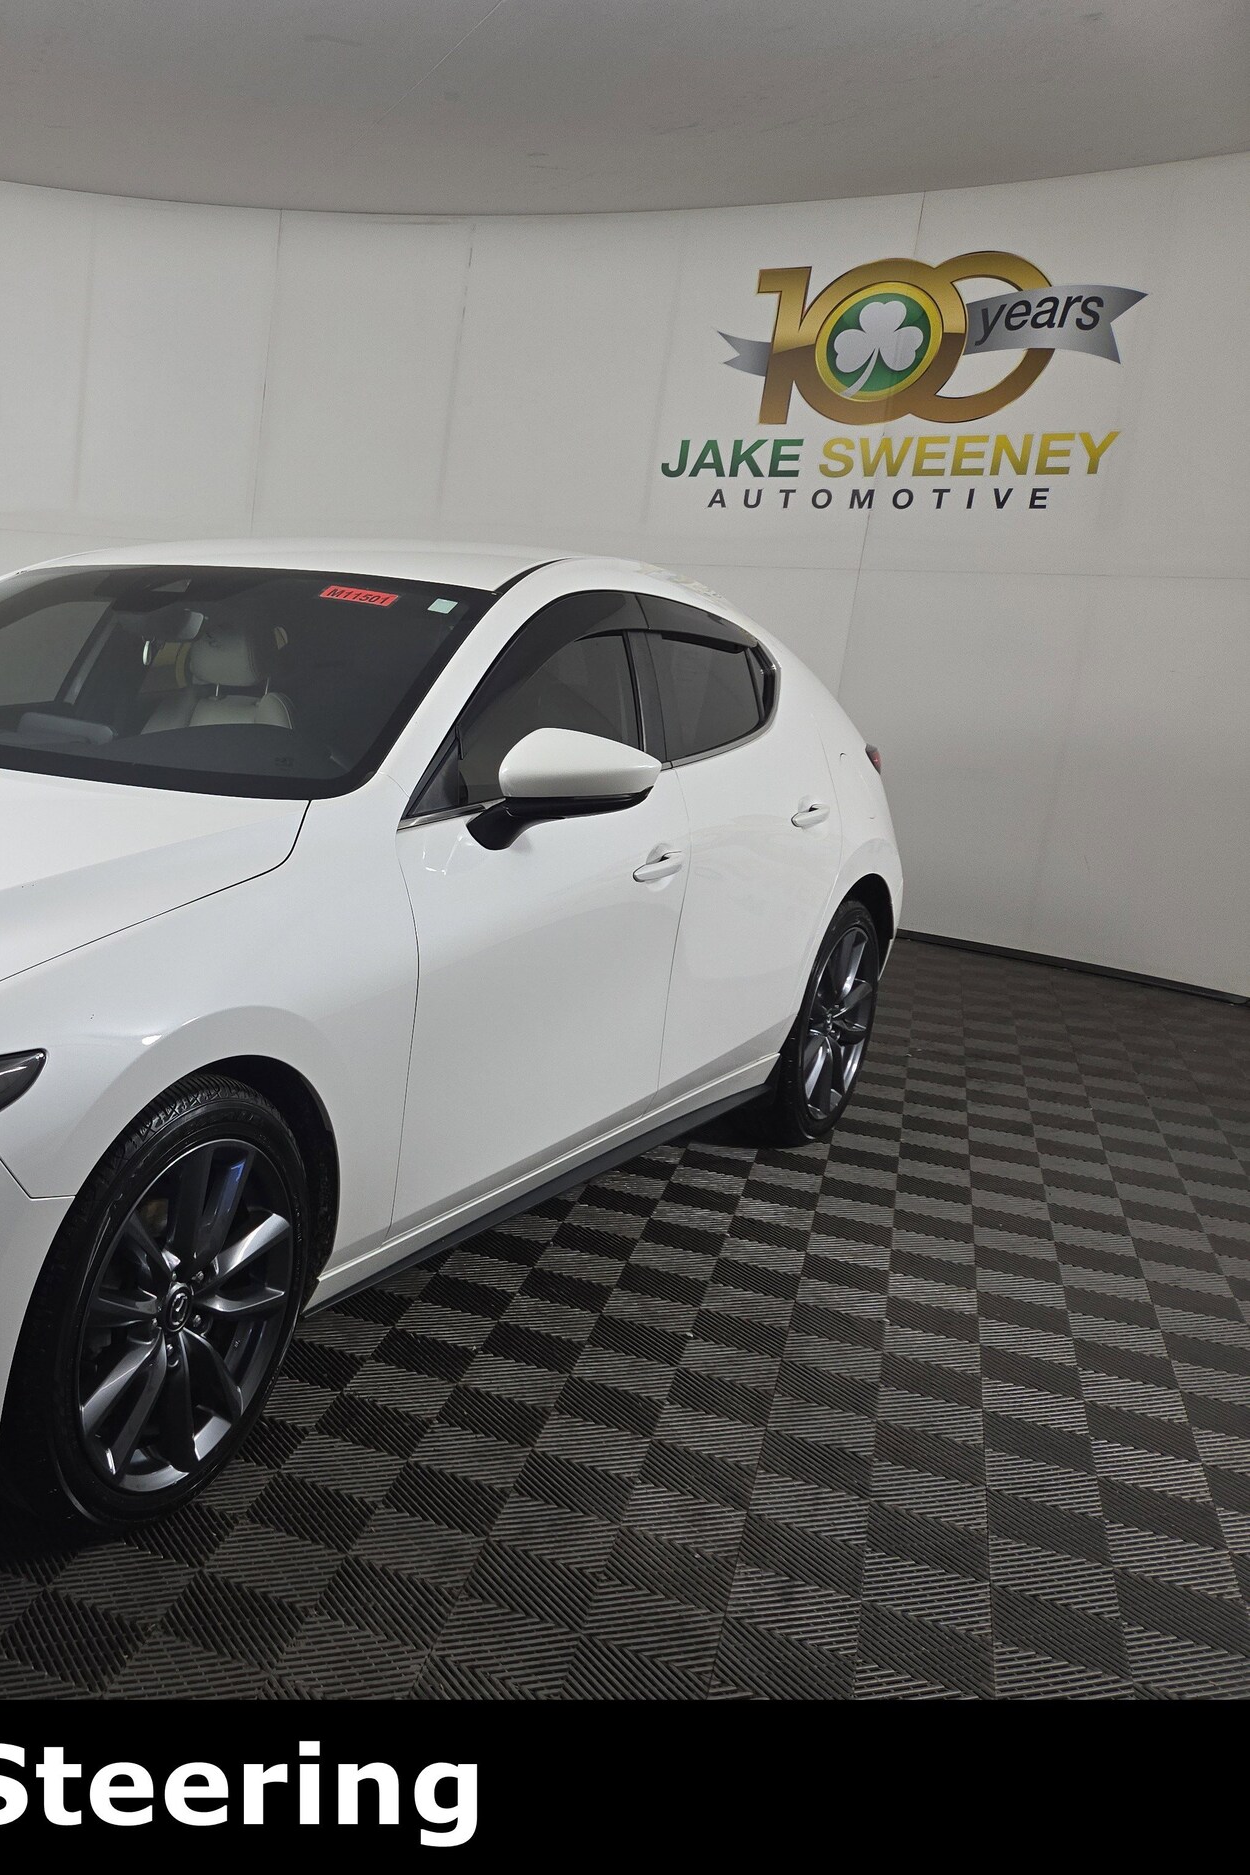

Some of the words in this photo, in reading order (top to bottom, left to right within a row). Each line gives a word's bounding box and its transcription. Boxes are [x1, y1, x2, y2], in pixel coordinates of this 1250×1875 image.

[757, 250, 1055, 425] 100
[975, 292, 1104, 346] years
[660, 438, 803, 478] JAKE
[818, 431, 1118, 478] SWEENEY
[708, 488, 1049, 510] AUTOMOTIVE
[327, 588, 390, 604] M11501
